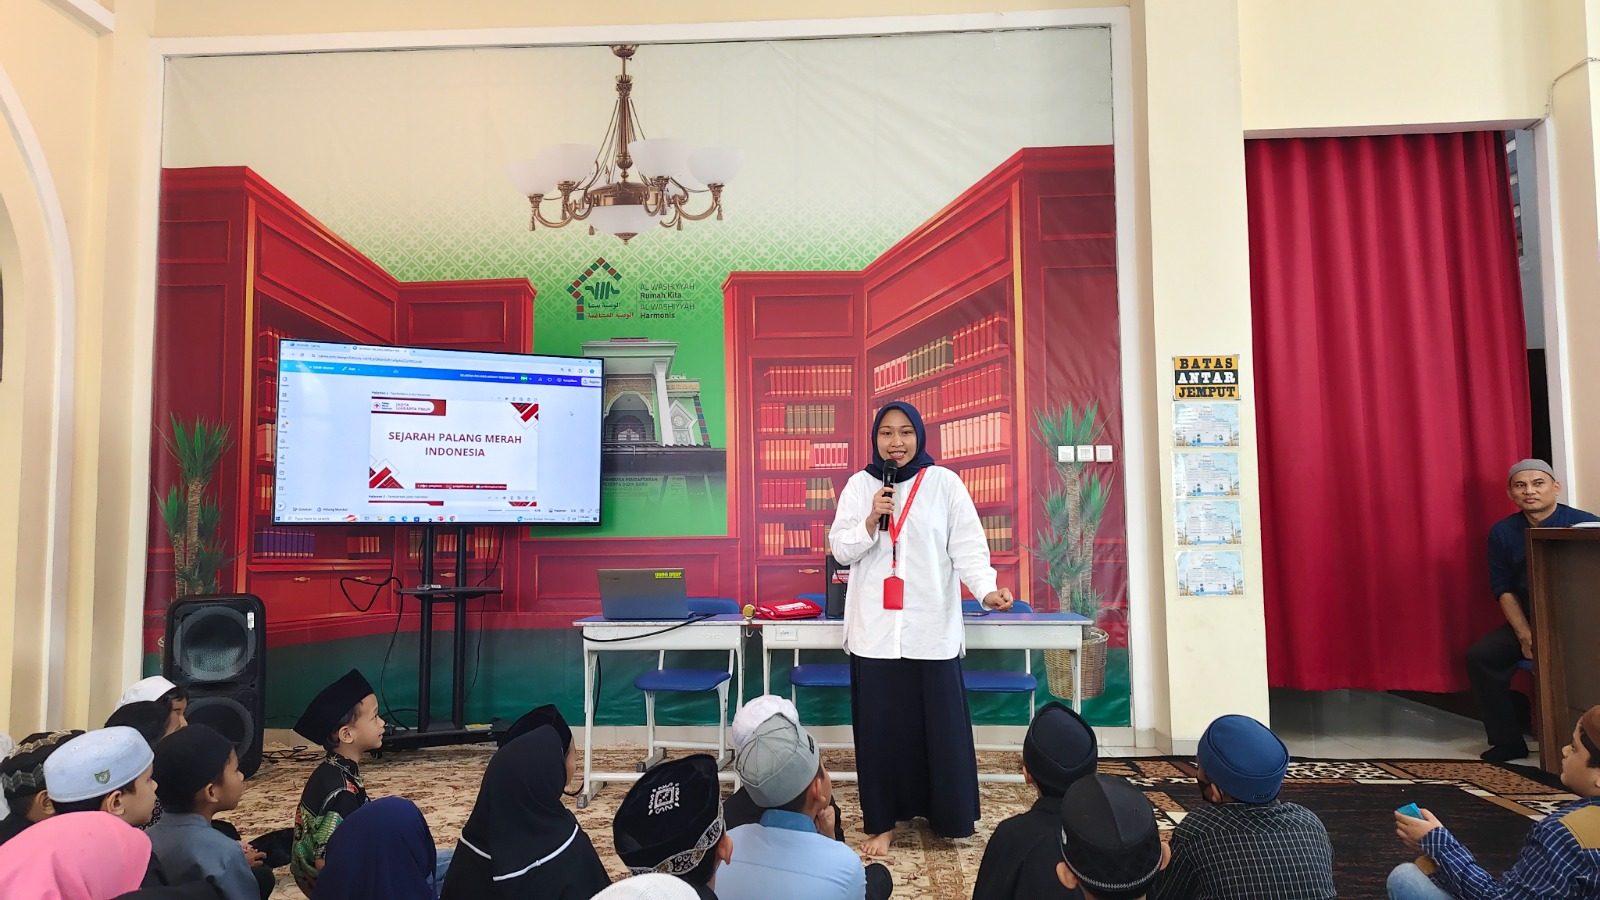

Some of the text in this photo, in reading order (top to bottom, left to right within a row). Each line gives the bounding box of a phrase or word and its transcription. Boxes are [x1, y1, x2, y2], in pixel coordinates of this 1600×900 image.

[640, 283, 695, 291] AL WASHIYYAH
[640, 303, 649, 311] AL
[1179, 358, 1233, 369] BATAS
[1177, 371, 1236, 384] ANTAR
[1178, 386, 1236, 398] JEMPUT
[388, 431, 522, 444] SEJARAH PALANG MERAH
[425, 447, 486, 457] INDONESIA
